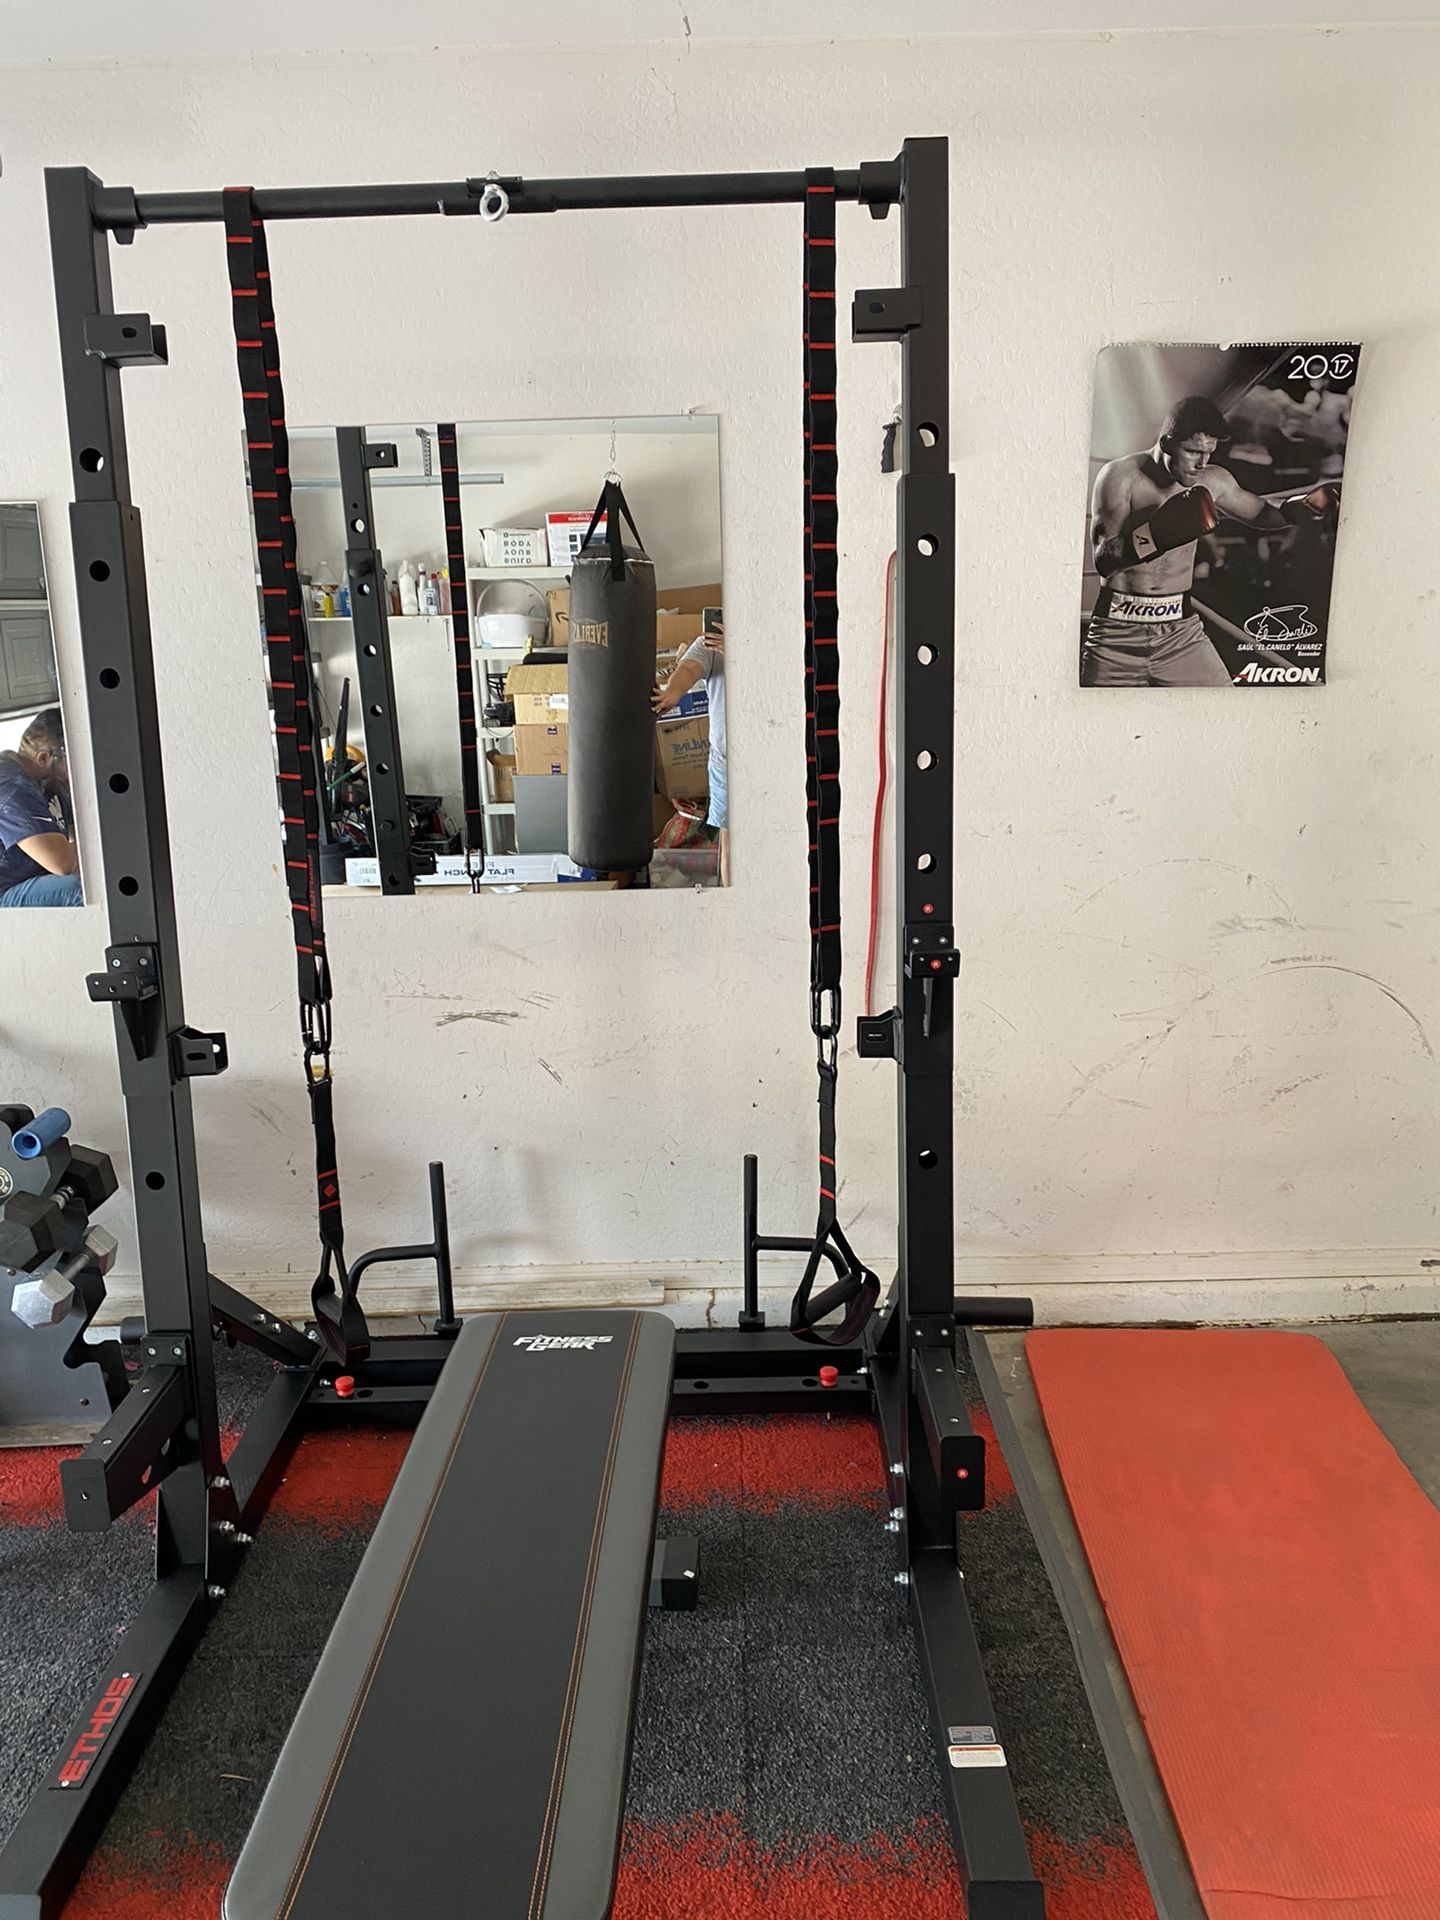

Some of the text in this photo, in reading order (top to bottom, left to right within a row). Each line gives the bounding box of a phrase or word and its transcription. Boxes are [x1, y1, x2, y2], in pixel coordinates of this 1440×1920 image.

[1287, 353, 1354, 380] 2017
[1111, 600, 1181, 617] AKRON
[1237, 643, 1254, 651] SAÚL
[1295, 642, 1323, 651] ÁLVAREZ
[1232, 662, 1320, 683] AKRON
[513, 1334, 613, 1347] FITNESS
[525, 1340, 594, 1352] GEAR
[58, 1677, 133, 1783] ETHOS
